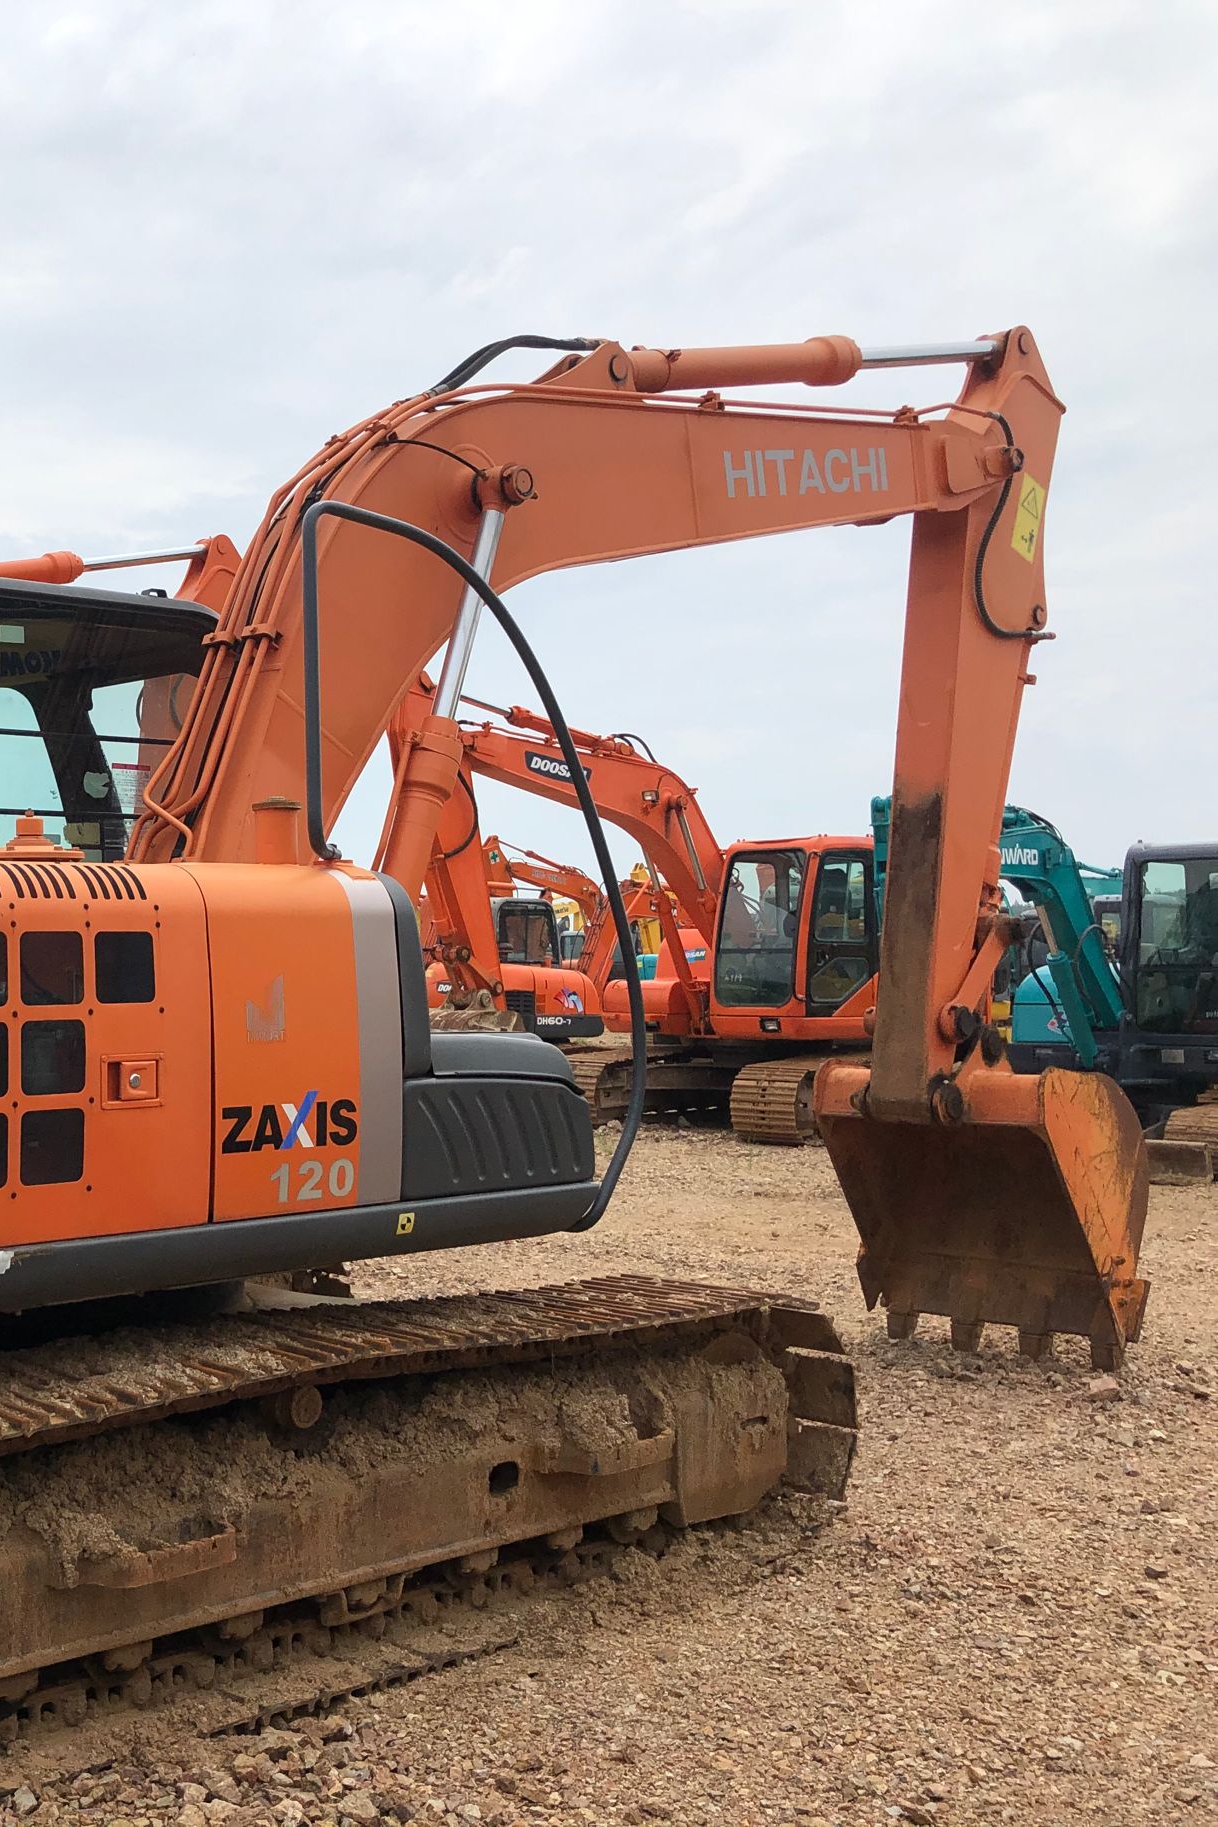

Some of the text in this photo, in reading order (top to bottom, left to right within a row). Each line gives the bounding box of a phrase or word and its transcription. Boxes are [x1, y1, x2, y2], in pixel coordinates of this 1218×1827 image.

[723, 447, 889, 498] HITACHI
[530, 756, 588, 778] DOOS
[1000, 842, 1039, 865] WARD
[537, 1016, 571, 1026] DH60-7
[221, 1090, 358, 1155] ZAXIS
[270, 1158, 355, 1204] 120
